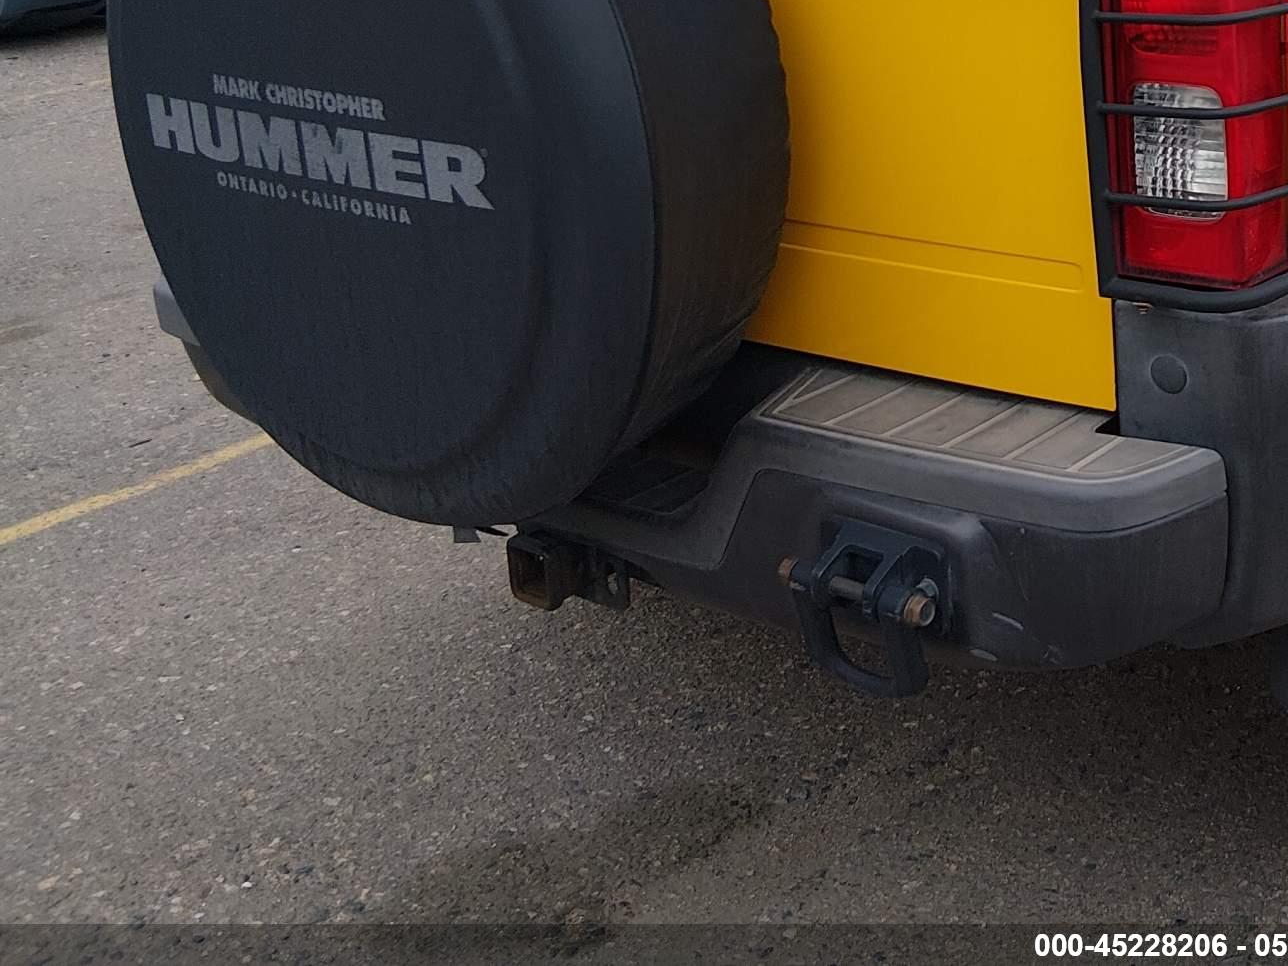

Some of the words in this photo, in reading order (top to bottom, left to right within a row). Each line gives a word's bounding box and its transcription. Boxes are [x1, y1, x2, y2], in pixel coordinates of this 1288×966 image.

[213, 73, 262, 102] MARK
[265, 84, 386, 121] CHRISTOPHER
[146, 92, 495, 211] HUMMER
[216, 171, 288, 200] ONTARIO
[301, 189, 412, 225] CALIFORNIA
